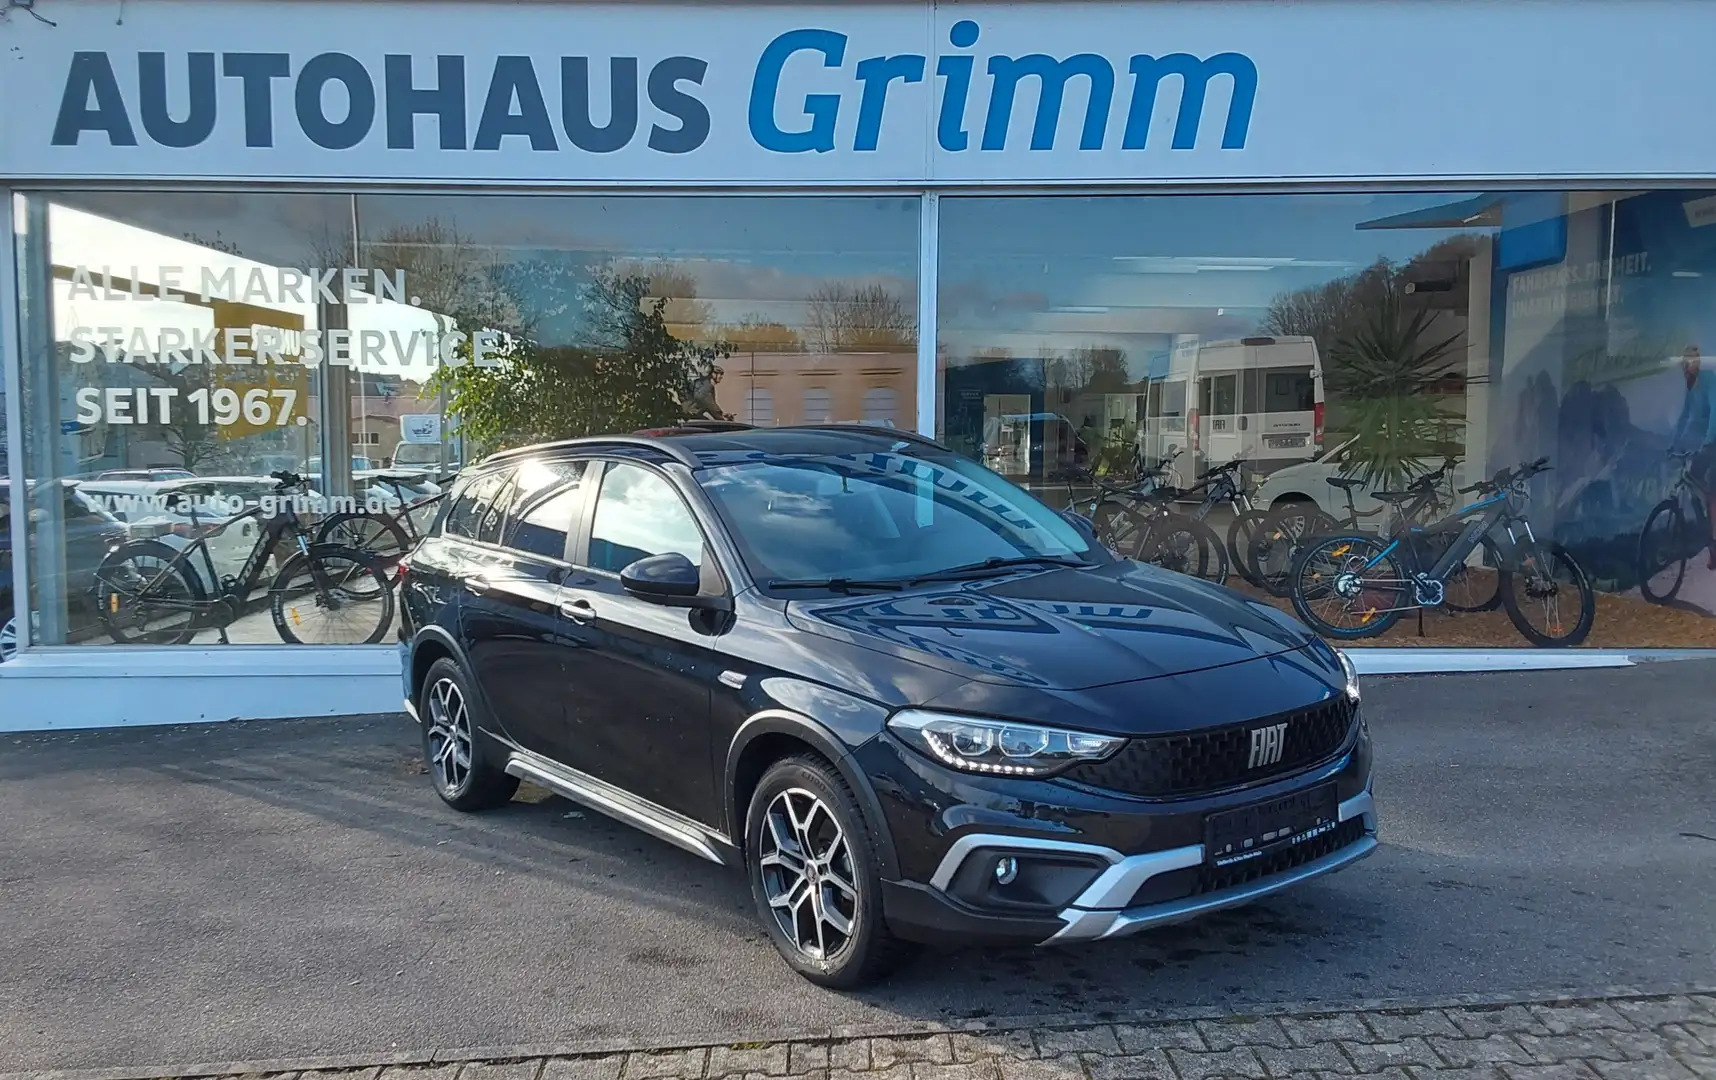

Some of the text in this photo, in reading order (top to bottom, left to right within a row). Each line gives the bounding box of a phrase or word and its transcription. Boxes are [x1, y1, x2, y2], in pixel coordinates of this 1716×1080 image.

[51, 20, 1259, 154] AUTOHAUS Grimm
[68, 264, 422, 306] ALLE MARKEN.
[69, 326, 285, 366] STARKER
[75, 387, 308, 427] SEIT 1967.
[86, 490, 402, 520] www.auto-grimm.de
[1248, 722, 1288, 769] FIAT
